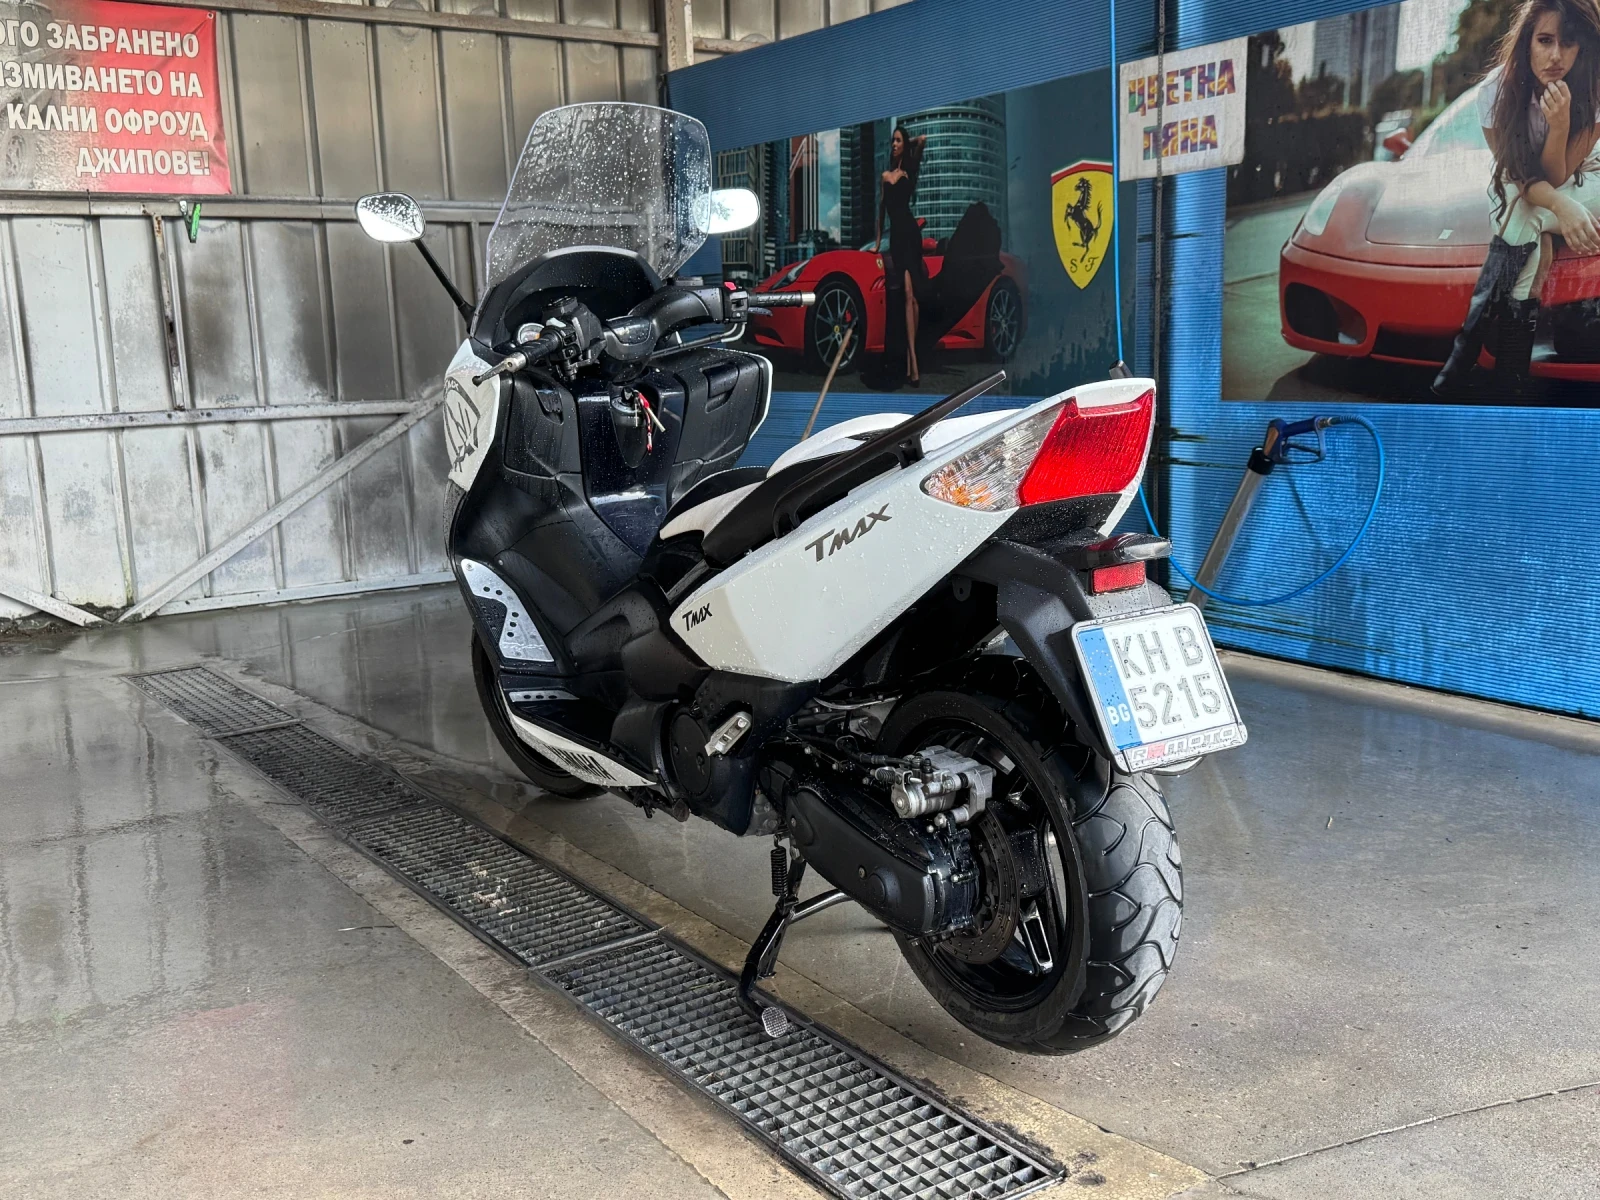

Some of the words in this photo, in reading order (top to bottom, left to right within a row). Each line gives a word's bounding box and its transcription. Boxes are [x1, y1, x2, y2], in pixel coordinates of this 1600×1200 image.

[46, 22, 199, 58] ЗАБРАНЕНО
[0, 61, 163, 96] ЗМИВАНЕТО
[169, 71, 204, 98] НА
[1128, 58, 1236, 117] ЦВЕТНА
[7, 103, 98, 133] КАЛНИ
[104, 108, 209, 142] ОФРОУД
[1143, 114, 1218, 161] ПЯНА
[76, 147, 211, 178] ДЖИПОВЕ!
[804, 503, 893, 563] TMAX
[682, 603, 713, 632] TMAX
[1111, 630, 1171, 679] KH
[1172, 625, 1204, 667] B
[1106, 703, 1131, 725] BG
[1129, 672, 1222, 728] 5215
